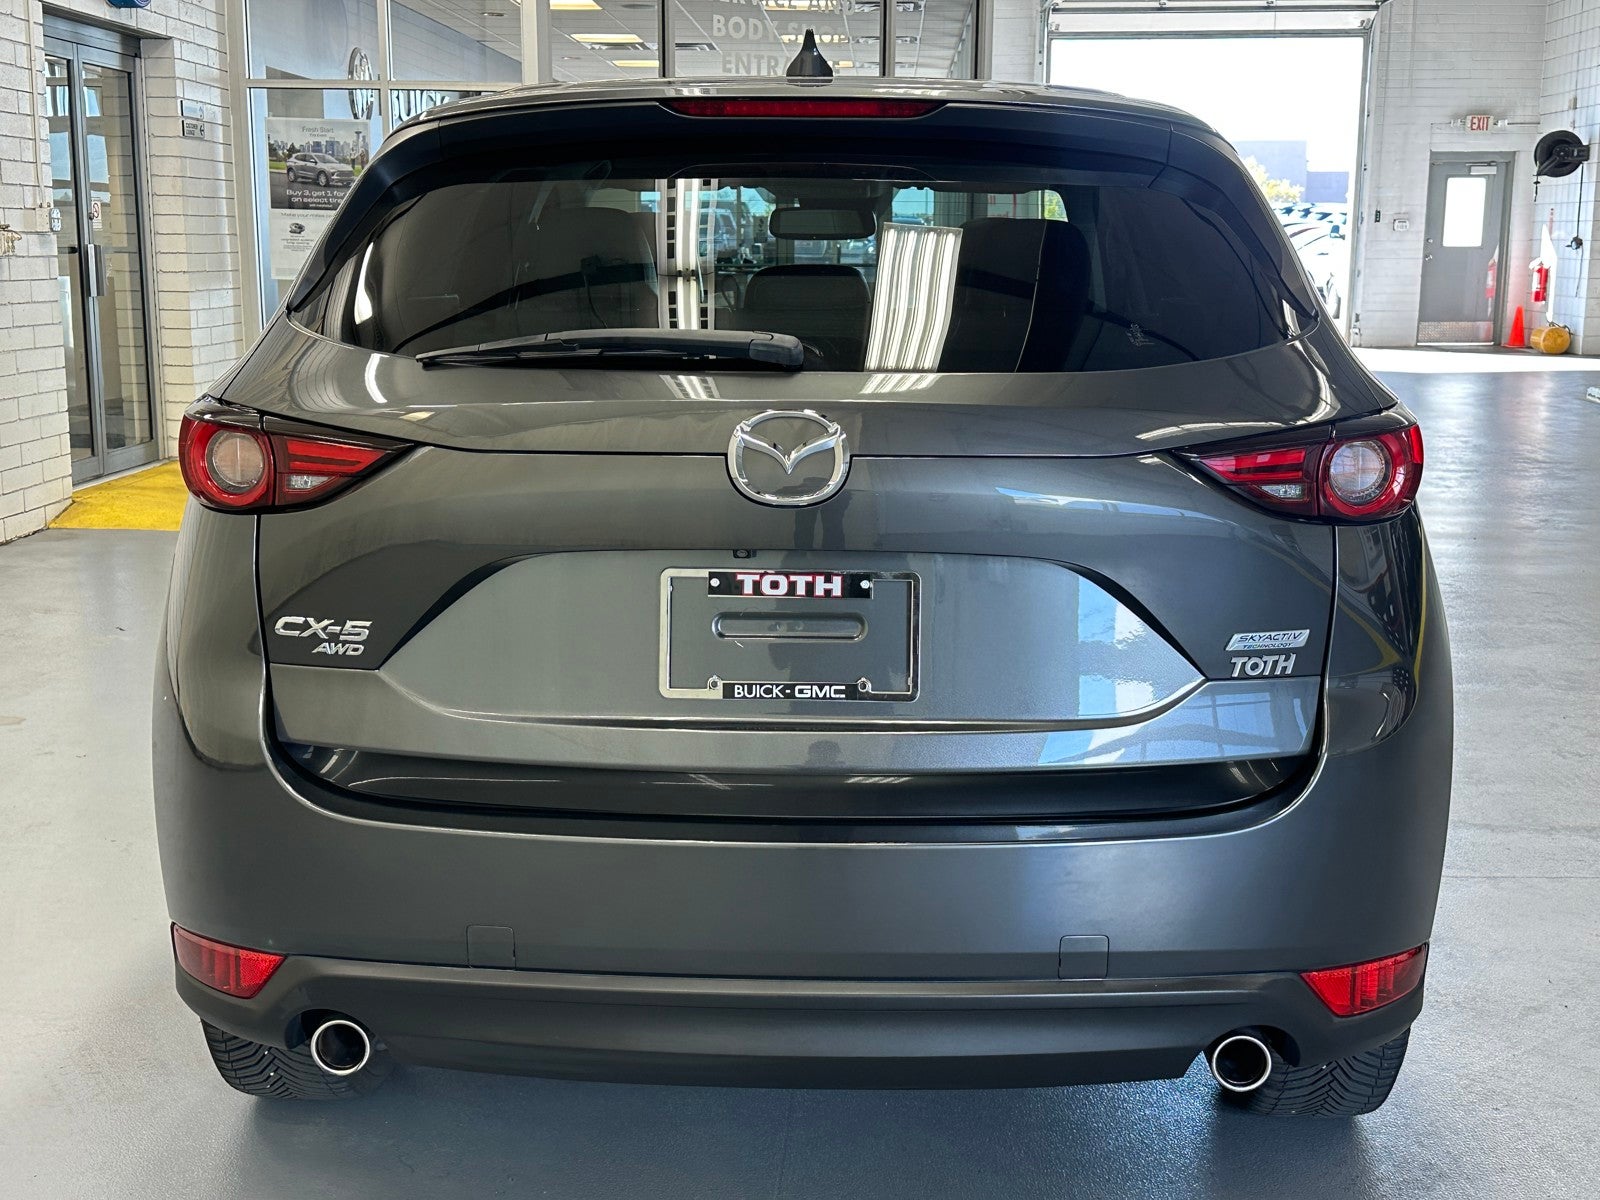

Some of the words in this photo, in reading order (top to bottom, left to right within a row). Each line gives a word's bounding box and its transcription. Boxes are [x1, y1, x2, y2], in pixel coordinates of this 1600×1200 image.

[712, 14, 779, 42] BODY
[1470, 116, 1490, 131] EXIT
[286, 189, 302, 197] Buy
[312, 190, 326, 198] get
[735, 572, 843, 598] TOTH
[274, 615, 373, 642] CX-5
[1238, 631, 1303, 642] SKYACTIV
[311, 642, 365, 656] AWD
[1242, 641, 1294, 650] TECHNOLOGY
[1230, 652, 1297, 678] TOTH
